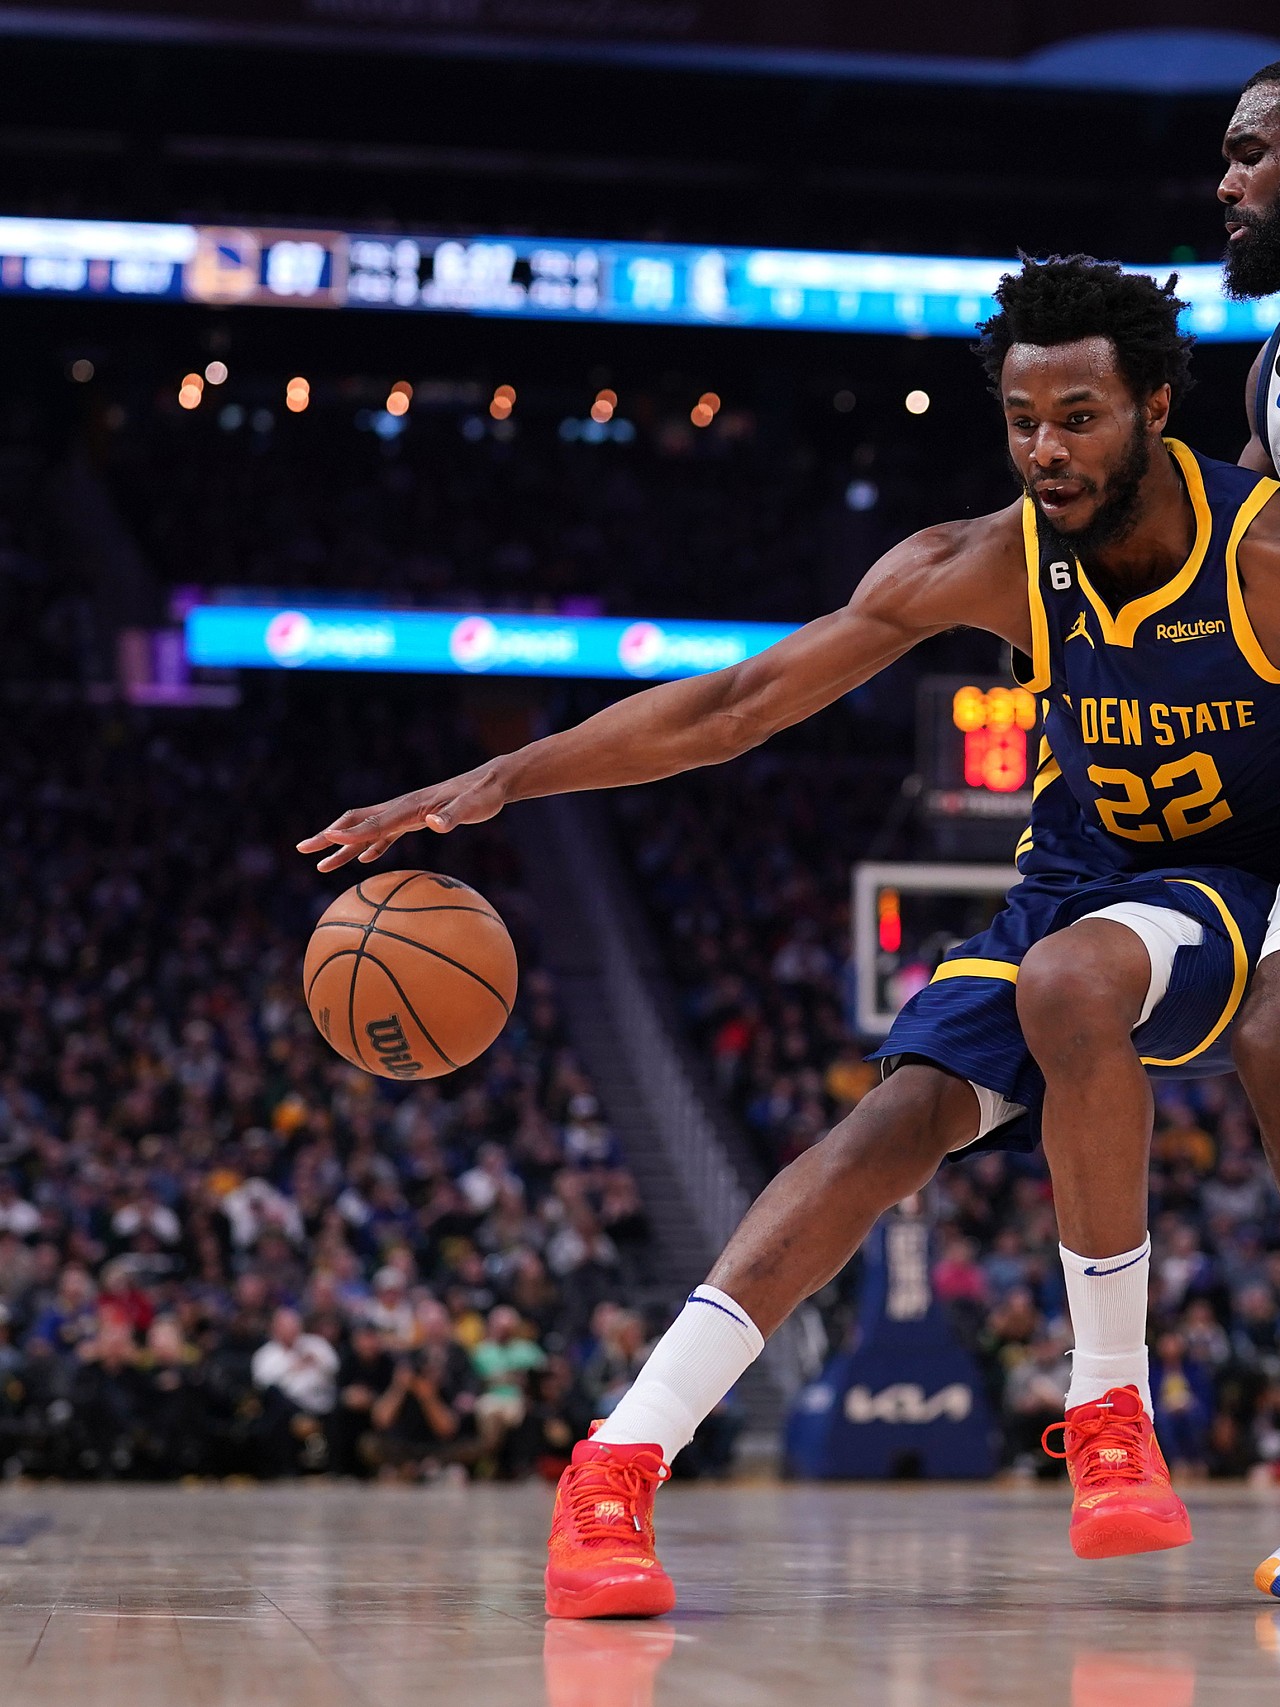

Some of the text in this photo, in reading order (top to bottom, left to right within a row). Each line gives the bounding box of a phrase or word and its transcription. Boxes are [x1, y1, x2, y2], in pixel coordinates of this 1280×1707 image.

[1049, 561, 1071, 590] 6
[1156, 619, 1226, 642] Rakuten
[1063, 694, 1142, 746] DEN
[1149, 700, 1256, 746] STATE
[1087, 751, 1233, 842] 22
[365, 1013, 423, 1077] Wil
